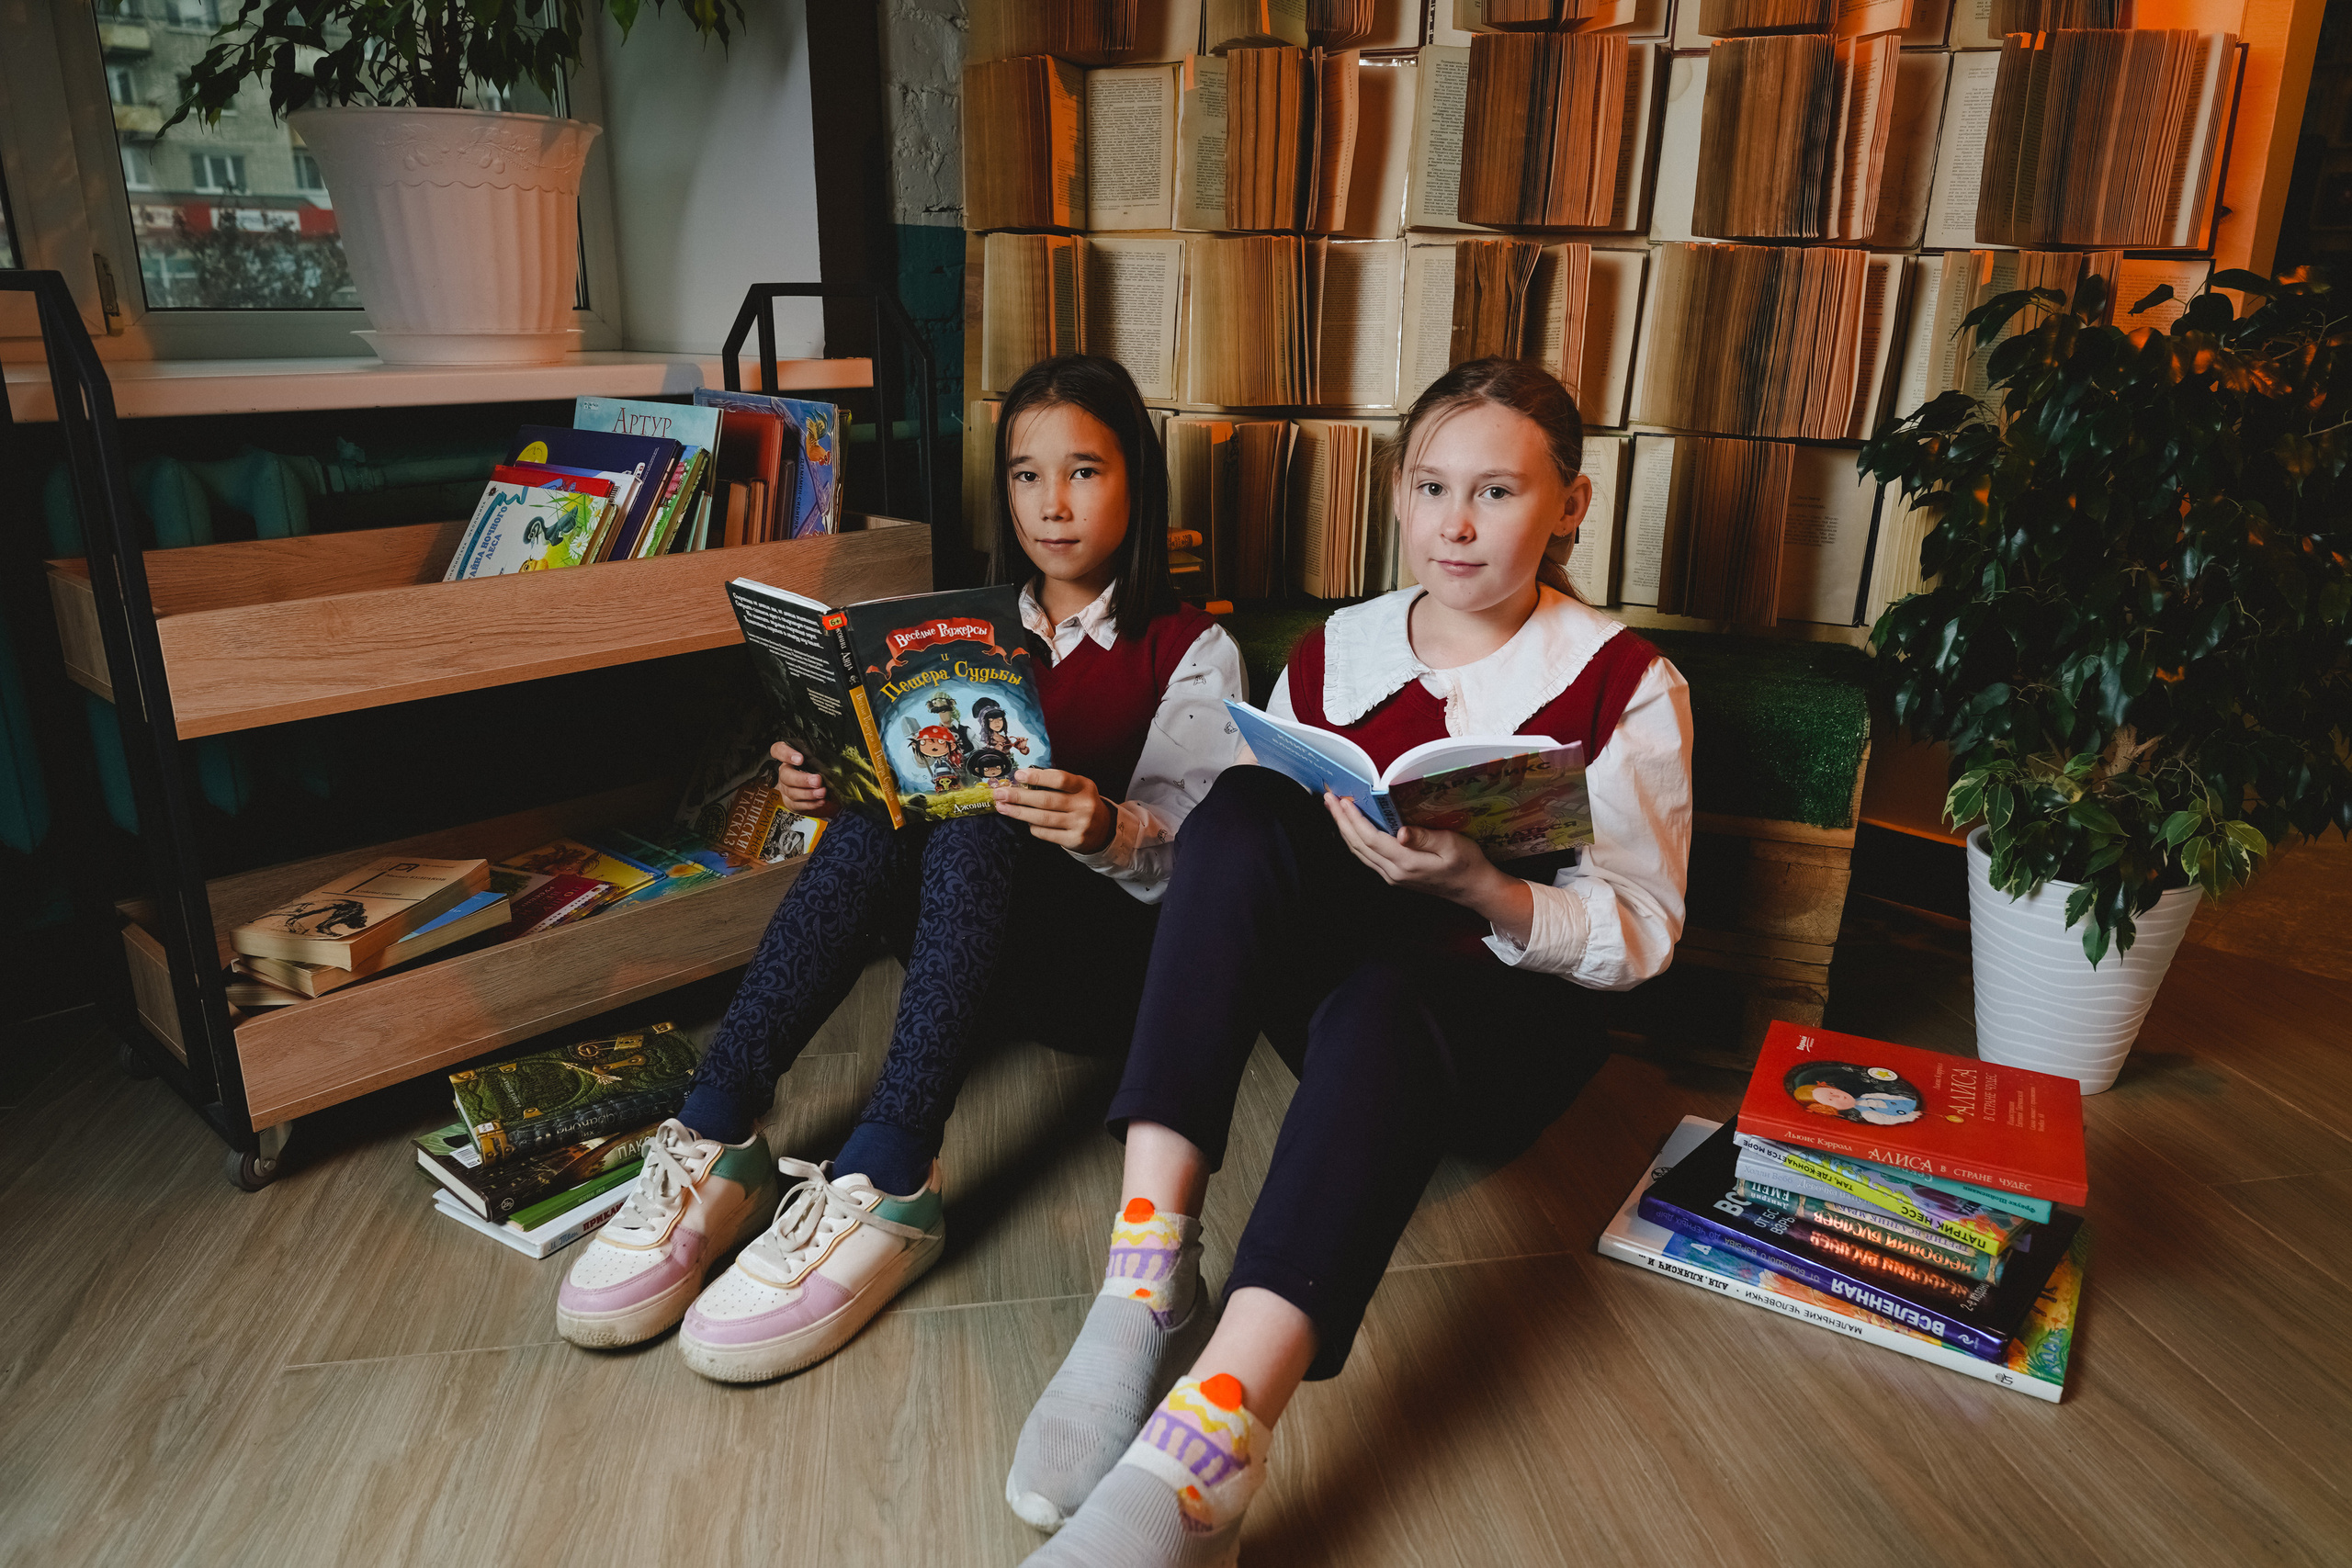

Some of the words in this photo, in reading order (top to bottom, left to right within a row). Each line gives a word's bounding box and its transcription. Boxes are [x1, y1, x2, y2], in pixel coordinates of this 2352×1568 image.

[468, 550, 485, 579] АЙНА
[481, 506, 508, 549] НОЧНОГО
[485, 534, 503, 559] ЛЕСА
[831, 618, 841, 626] 6+
[937, 623, 988, 637] Роджерсы
[941, 653, 949, 661] и
[880, 669, 951, 703] Пещера
[954, 660, 1023, 685] Судьбы
[735, 786, 769, 853] ДЕНИСКИ
[1948, 1067, 1977, 1117] АЛИСА
[1985, 1073, 1997, 1091] ЧУДЕС
[1984, 1090, 1996, 1115] СТРАНЕ
[1743, 1139, 1766, 1154] МОРЕ
[1767, 1149, 1816, 1176] КОНЧАЕТСЯ
[1784, 1131, 1815, 1144] Льюис
[1817, 1138, 1853, 1153] Кэрролл
[1868, 1148, 1933, 1173] АЛИСА
[1939, 1165, 1947, 1173] В
[1953, 1168, 1993, 1183] СТРАНЕ
[1998, 1177, 2032, 1191] ЧУДЕС
[1744, 1166, 1770, 1179] Холли
[1771, 1173, 1793, 1183] Вебб
[1797, 1178, 1838, 1197] Девочка
[1816, 1168, 1832, 1182] ГДЕ
[1750, 1191, 1789, 1210] Дмитрий
[1751, 1181, 1790, 1201] ЕМЕЦ
[1832, 1201, 1866, 1220] МРАКА
[1901, 1206, 1934, 1225] НЕСС
[2008, 1201, 2036, 1214] Фрауке
[1754, 1211, 1770, 1228] ОТ
[1871, 1215, 1921, 1237] ВСАДНИК
[1724, 1236, 1758, 1255] ВЗРЫВА
[1926, 1232, 1969, 1253] ТРЕТИЙ
[1937, 1221, 1986, 1249] ПАТРИК
[1759, 1253, 1806, 1277] БОЛЬШОГО
[1809, 1273, 1820, 1282] ОТ
[1745, 1290, 1801, 1315] ЧЕЛОВЕЧКИ
[1830, 1278, 1946, 1337] ВСЕЛЕННАЯ
[1803, 1308, 1863, 1335] МАЛЕНЬКИЕ
